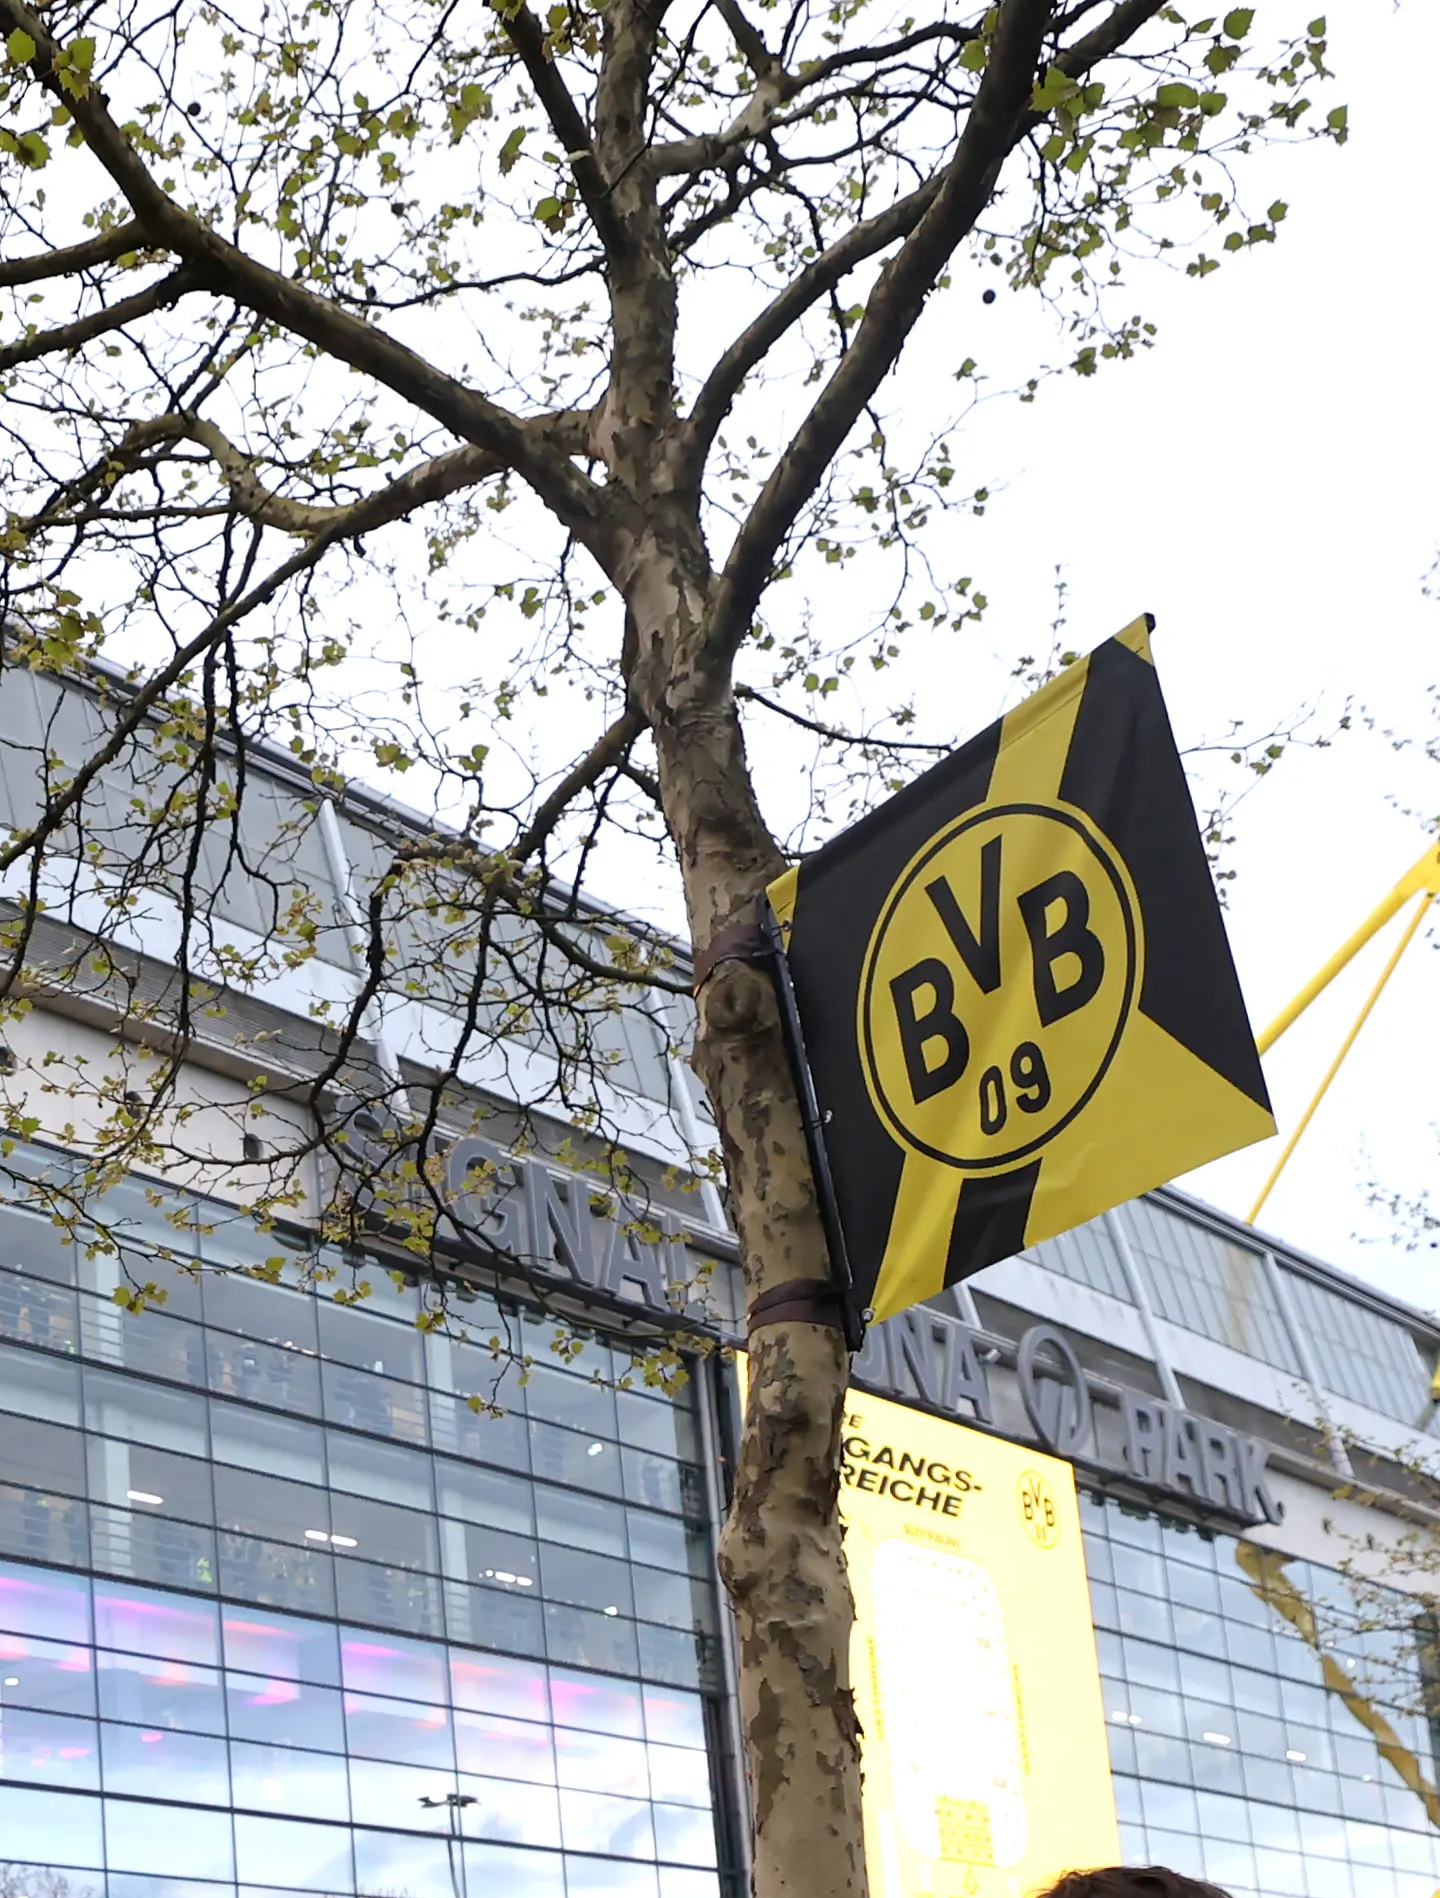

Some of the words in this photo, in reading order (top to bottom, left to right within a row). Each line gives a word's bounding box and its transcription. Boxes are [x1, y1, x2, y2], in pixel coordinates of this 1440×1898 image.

[889, 834, 1105, 1105] BVB
[979, 1041, 1052, 1136] 09
[842, 1465, 964, 1518] REICHE
[844, 1436, 984, 1492] GANGS-
[1120, 1388, 1286, 1527] PARK
[1022, 1477, 1056, 1527] BVB
